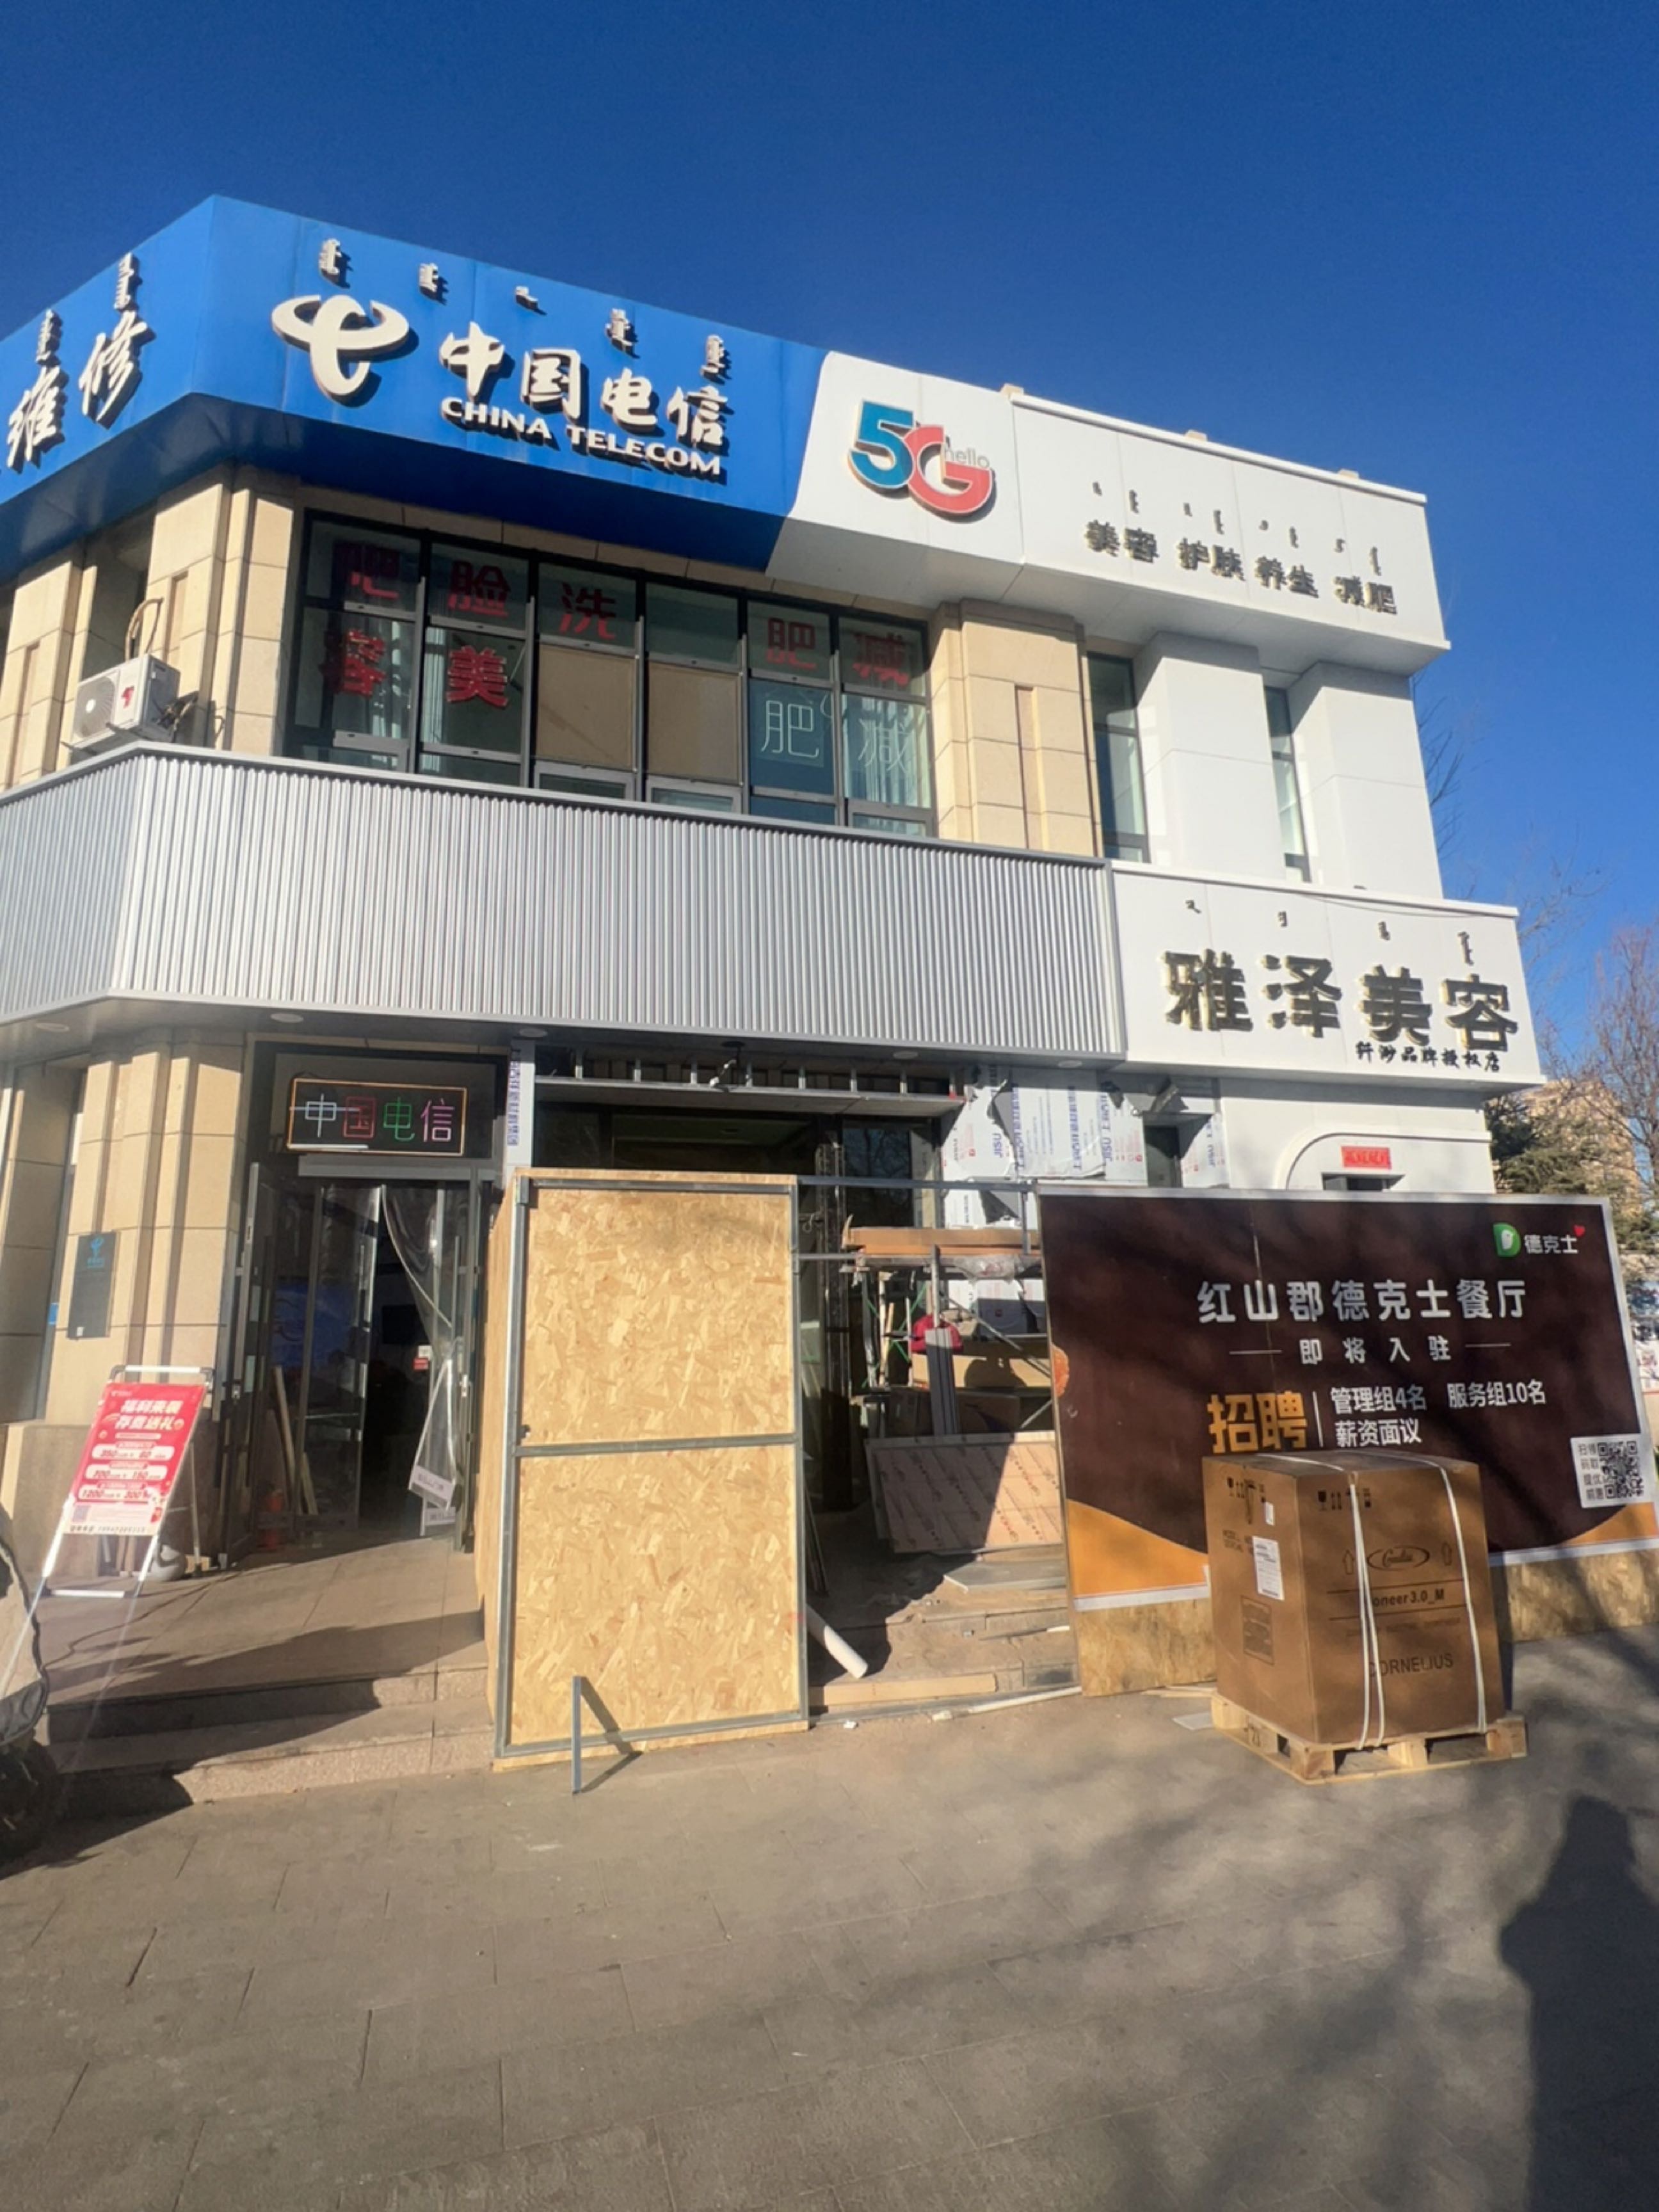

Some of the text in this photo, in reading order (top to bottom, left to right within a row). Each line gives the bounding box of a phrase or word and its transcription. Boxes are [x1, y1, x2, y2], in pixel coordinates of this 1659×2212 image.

[439, 321, 728, 446] 中国电信
[441, 396, 720, 475] CHINA TELECOM
[848, 399, 993, 516] 5G
[943, 447, 990, 469] hello
[1085, 519, 1159, 563] 美容
[1176, 538, 1246, 581] 护肤
[1254, 555, 1320, 598] 养生
[1334, 575, 1398, 614] 减肥
[1162, 949, 1518, 1052] 雅泽美容
[304, 1093, 455, 1142] 中国电信
[1524, 1234, 1579, 1254] 德克士
[1197, 1279, 1526, 1324] 红山郡德克士餐厅
[1299, 1335, 1451, 1365] 即将入驻
[1331, 1379, 1546, 1414] 管理组4名 服务组10名
[1206, 1390, 1308, 1454] 招聘
[1334, 1418, 1423, 1448] 薪资面议
